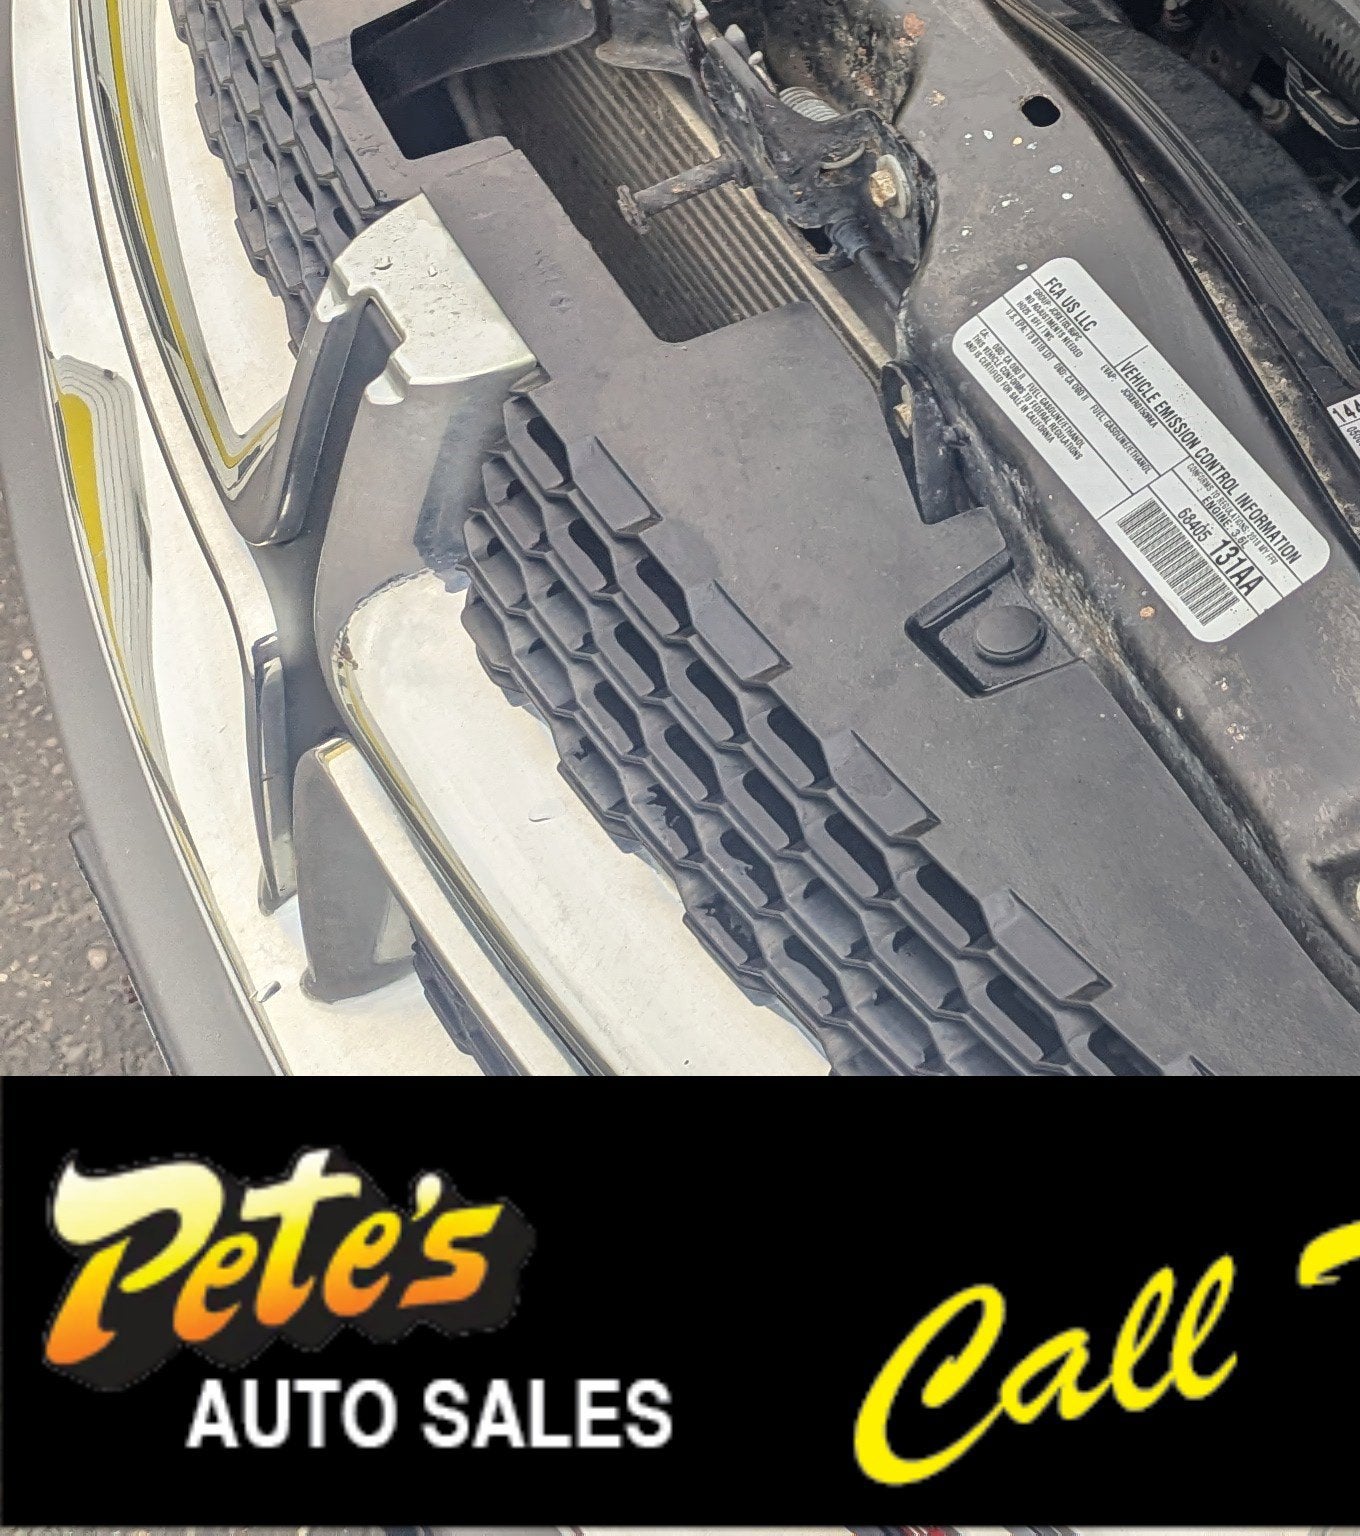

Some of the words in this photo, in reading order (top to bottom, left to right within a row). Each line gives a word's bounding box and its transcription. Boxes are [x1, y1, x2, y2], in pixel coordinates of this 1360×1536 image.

[1030, 301, 1065, 339] ADJUSTMENTS
[1061, 335, 1083, 358] NEEDED
[1043, 275, 1068, 300] FCA
[1059, 294, 1081, 314] US
[1072, 308, 1098, 333] LLC
[963, 339, 977, 353] AND
[977, 355, 1004, 383] CERTIFIED
[1008, 390, 1024, 407] SALE
[1024, 410, 1055, 443] CALIFORNIA
[971, 333, 986, 348] THIS
[981, 345, 1003, 368] VEHICLE
[998, 365, 1026, 394] CONFORMS
[1021, 392, 1033, 402] TO
[1028, 399, 1052, 425] FEDERAL
[1047, 422, 1083, 460] REGULATIONS
[1038, 396, 1086, 449] GASOLINE/ETHANOL
[1102, 419, 1153, 474] GASOLINE/ETHANOL
[1119, 360, 1161, 404] VEHICLE
[1153, 399, 1202, 450] EMISSION
[1193, 445, 1242, 496] CONTROL
[1233, 491, 1302, 565] INFORMATION
[1176, 506, 1212, 543] 68405
[1206, 536, 1267, 596] 131AA
[1201, 495, 1234, 530] ENGINE:
[1229, 528, 1251, 549] 3.6L
